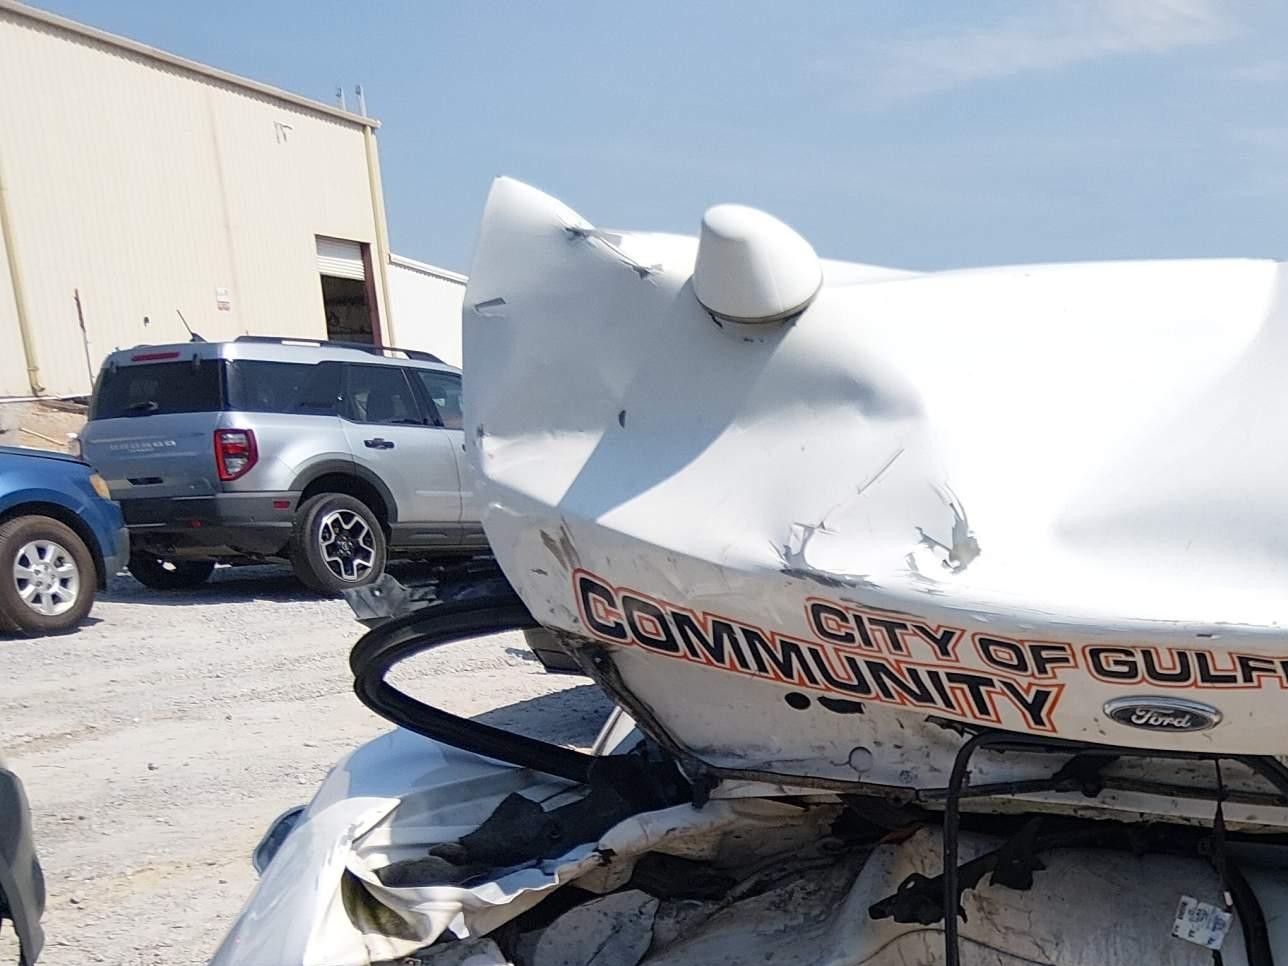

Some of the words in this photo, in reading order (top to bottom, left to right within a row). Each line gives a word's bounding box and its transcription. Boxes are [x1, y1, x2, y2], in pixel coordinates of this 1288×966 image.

[575, 570, 1062, 732] COMMUNITY
[805, 598, 965, 663] CITY
[973, 633, 1076, 679] OF
[1130, 706, 1192, 728] Ford
